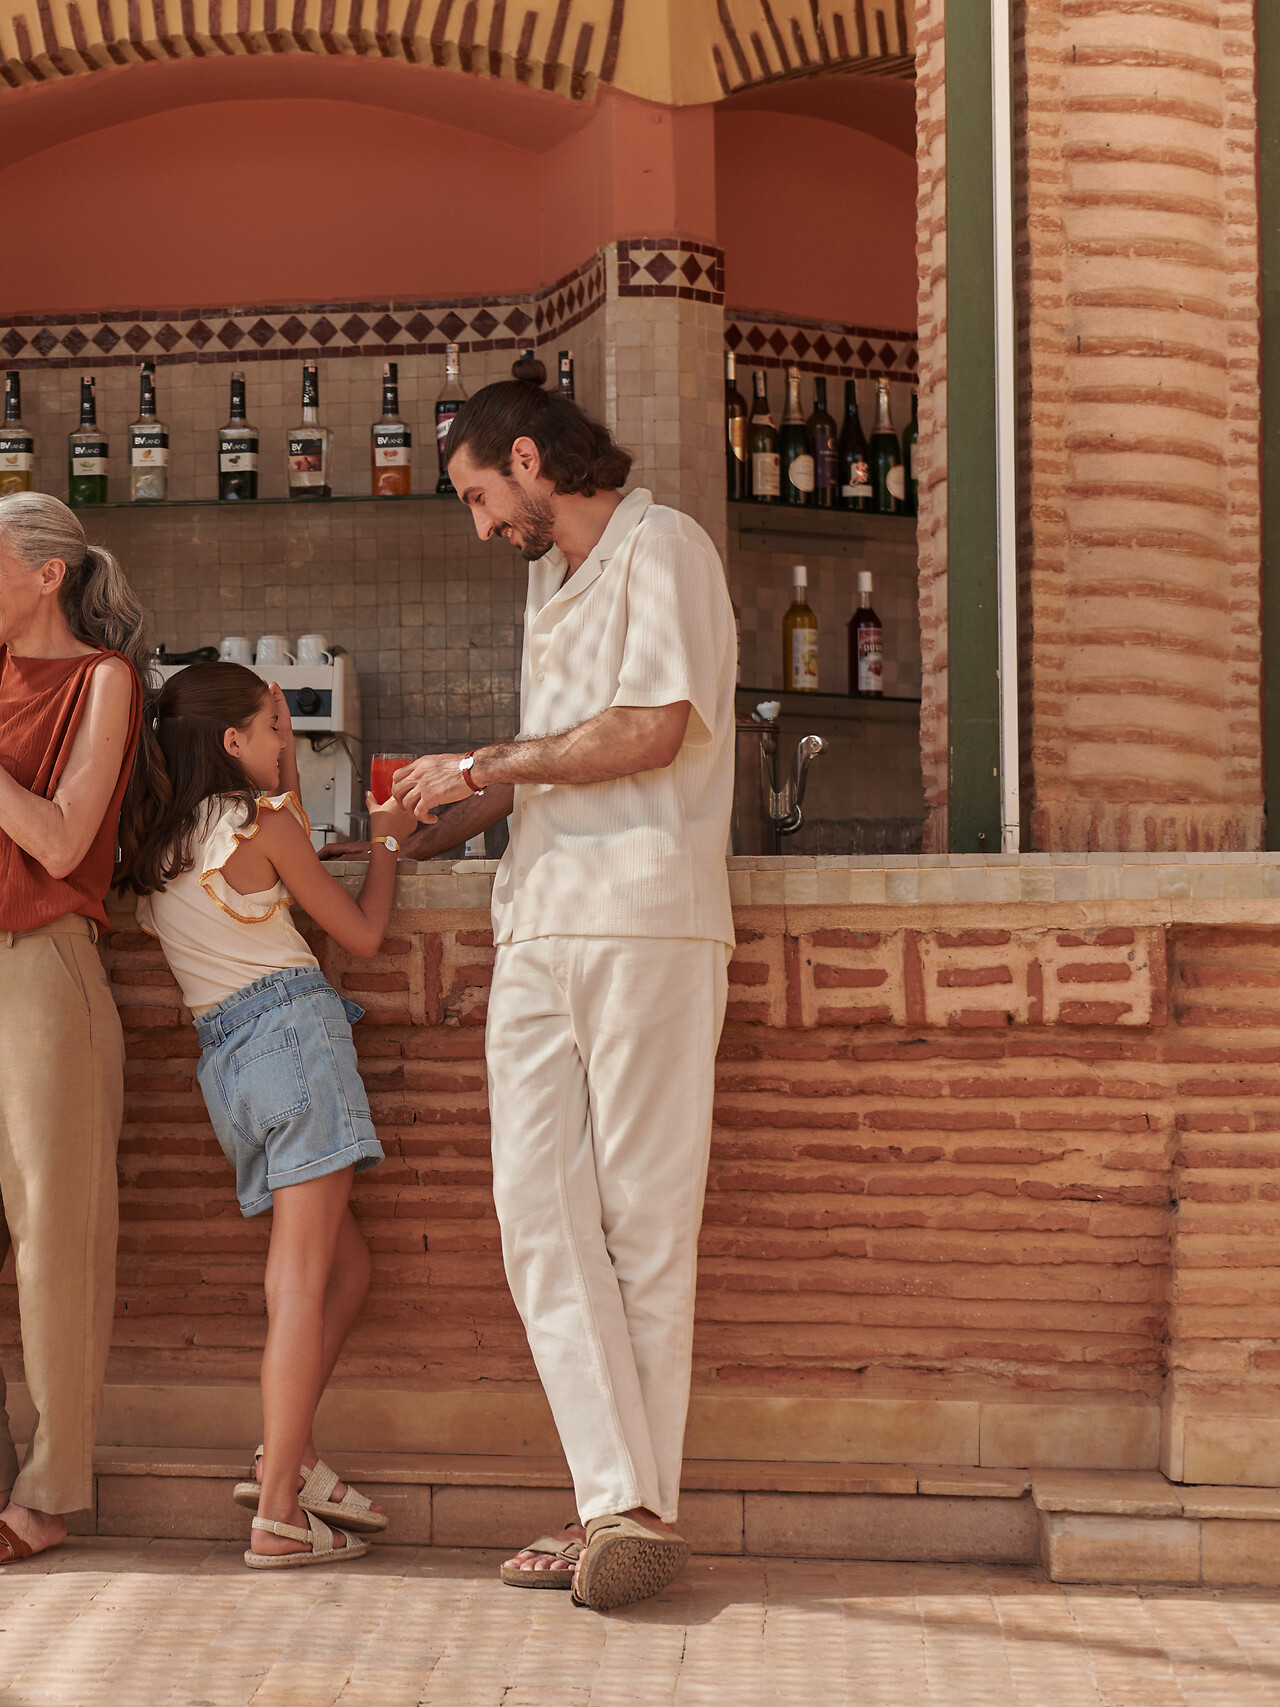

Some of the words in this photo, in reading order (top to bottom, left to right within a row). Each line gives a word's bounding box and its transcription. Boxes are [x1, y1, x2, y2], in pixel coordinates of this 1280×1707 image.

[135, 437, 145, 445] BV
[377, 436, 388, 445] BV
[222, 442, 232, 450] BV
[291, 443, 302, 451] BV
